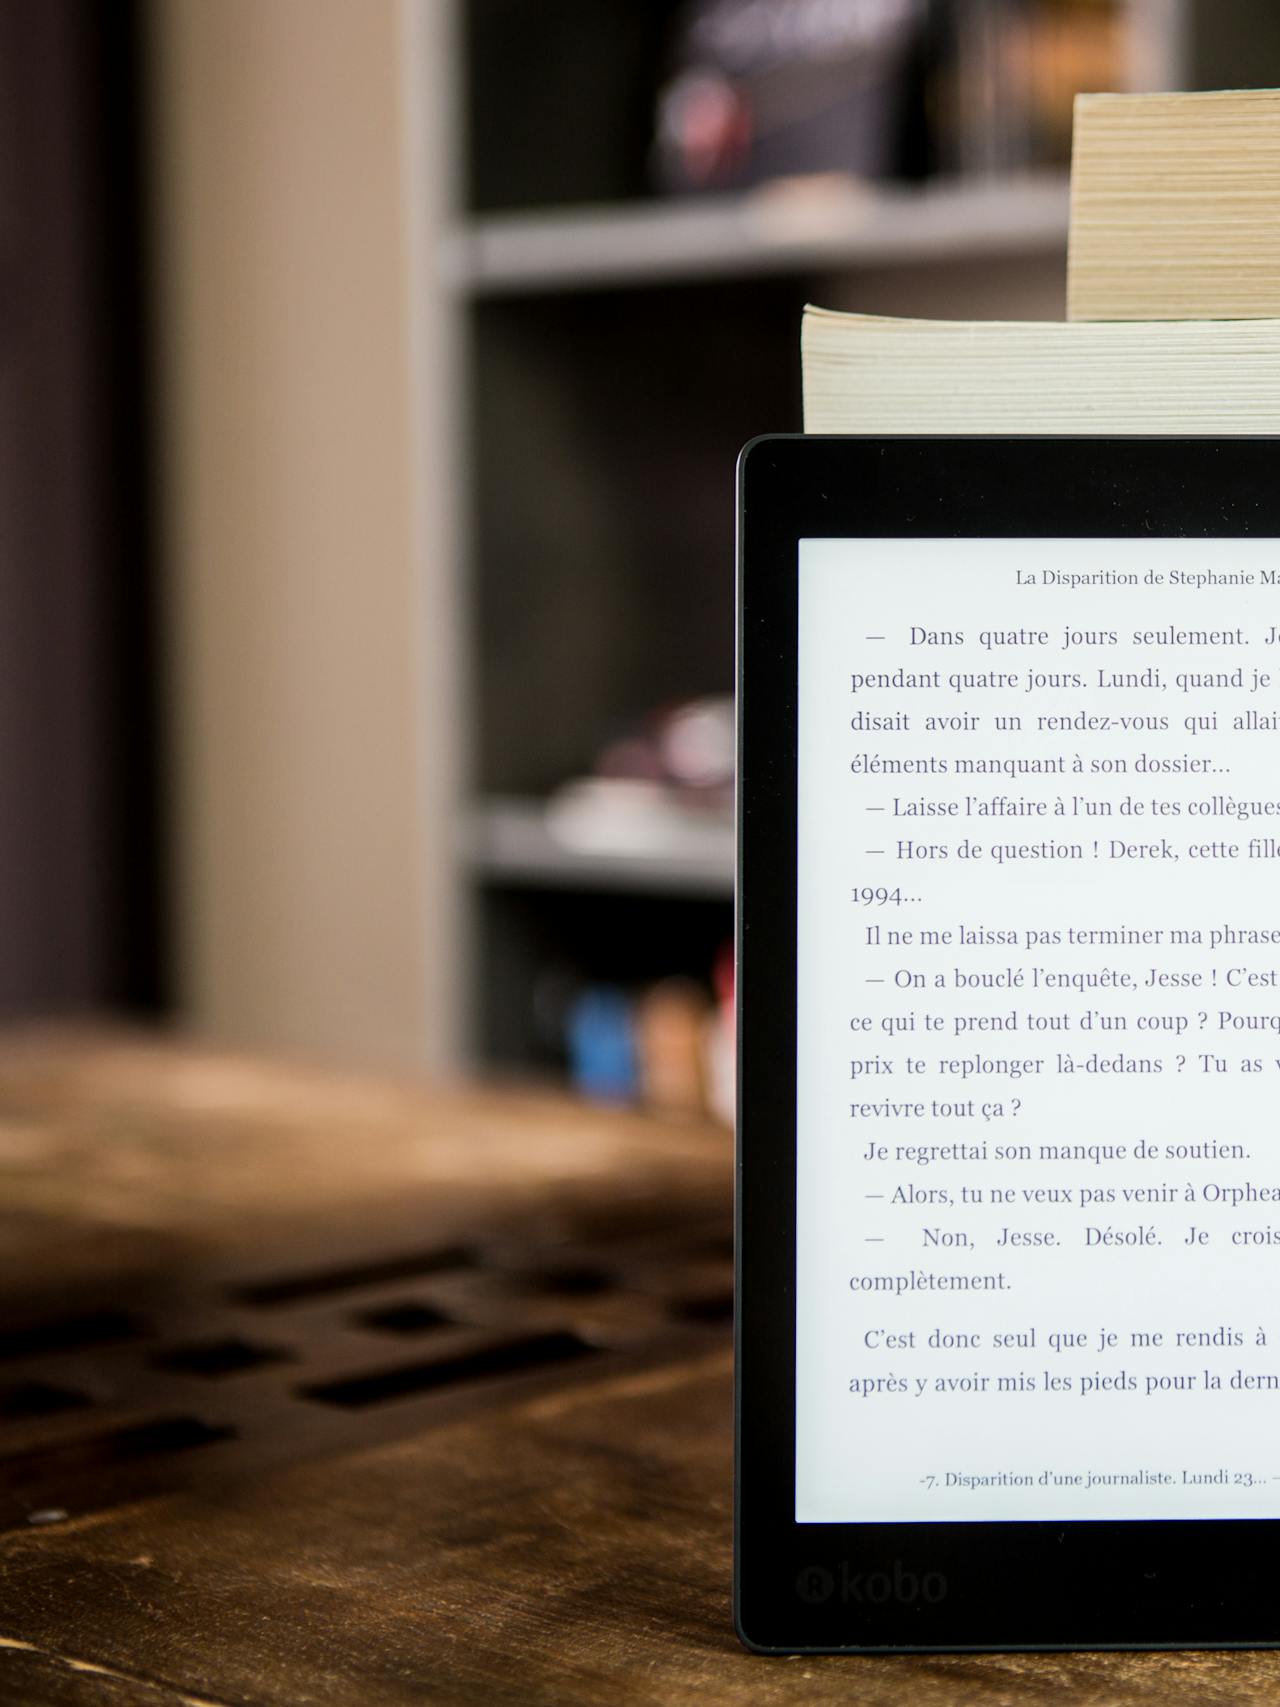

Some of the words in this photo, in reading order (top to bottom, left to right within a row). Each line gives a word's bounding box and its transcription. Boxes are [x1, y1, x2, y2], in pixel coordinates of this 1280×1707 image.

[1015, 569, 1037, 585] La
[1041, 569, 1139, 590] Disparition
[1143, 568, 1165, 585] de
[1168, 568, 1255, 590] Stephanie
[909, 626, 965, 646] Dans
[978, 628, 1049, 651] quatre
[1061, 625, 1121, 651] jours
[1132, 625, 1249, 646] seulement.
[850, 667, 941, 694] pendant
[948, 671, 1019, 694] quatre
[1024, 668, 1088, 694] jours.
[1097, 667, 1167, 692] Lundi,
[1175, 667, 1244, 694] quand
[1249, 668, 1271, 693] je
[850, 710, 911, 731] disait
[924, 711, 981, 731] avoir
[993, 716, 1022, 731] un
[1036, 710, 1169, 731] rendez-vous
[1183, 710, 1218, 736] qui
[850, 753, 948, 774] éléments
[953, 755, 1067, 779] manquant
[1090, 759, 1128, 774] son
[1134, 751, 1231, 774] dossier...
[892, 796, 959, 817] Laisse
[964, 795, 1048, 817] l’affaire
[1071, 795, 1113, 817] l’un
[1119, 795, 1145, 816] de
[1150, 799, 1182, 816] tes
[896, 840, 949, 860] Hors
[956, 838, 983, 860] de
[990, 839, 1083, 865] question
[1108, 838, 1180, 863] Derek,
[1188, 841, 1240, 859] cette
[851, 887, 922, 907] 1994...
[865, 924, 881, 946] Il
[887, 930, 913, 946] ne
[919, 930, 953, 945] me
[958, 924, 1019, 945] laissa
[1024, 930, 1062, 950] pas
[1066, 924, 1164, 945] terminer
[1169, 929, 1204, 945] ma
[894, 969, 927, 989] On
[933, 973, 947, 989] a
[953, 967, 1025, 989] bouclé
[1031, 967, 1138, 993] l’enquête,
[1144, 967, 1203, 988] Jesse
[1226, 967, 1278, 988] C’est
[849, 1016, 873, 1032] ce
[880, 1011, 916, 1037] qui
[923, 1013, 945, 1032] te
[953, 1010, 1019, 1037] prend
[1026, 1013, 1071, 1031] tout
[1079, 1009, 1128, 1031] d’un
[1136, 1015, 1189, 1037] coup
[849, 1054, 894, 1080] prix
[905, 1057, 926, 1075] te
[938, 1053, 1045, 1080] replonger
[1056, 1052, 1163, 1074] là-dedans
[1198, 1054, 1228, 1073] Tu
[1240, 1058, 1263, 1073] as
[849, 1097, 925, 1118] revivre
[930, 1099, 975, 1118] tout
[981, 1102, 1005, 1122] ça
[863, 1141, 889, 1161] Je
[895, 1140, 988, 1166] regrettai
[994, 1145, 1032, 1161] son
[1039, 1145, 1127, 1165] manque
[1132, 1138, 1159, 1160] de
[1164, 1139, 1251, 1160] soutien.
[890, 1183, 955, 1207] Alors,
[960, 1186, 983, 1204] tu
[989, 1189, 1016, 1205] ne
[1021, 1188, 1073, 1204] veux
[1079, 1188, 1116, 1209] pas
[1121, 1182, 1179, 1203] venir
[922, 1227, 975, 1251] Non,
[996, 1226, 1061, 1247] Jesse.
[1085, 1225, 1163, 1247] Désolé.
[1184, 1226, 1209, 1246] Je
[849, 1269, 1012, 1297] complètement.
[863, 1328, 916, 1350] C’est
[927, 1328, 981, 1349] donc
[992, 1327, 1036, 1348] seul
[1047, 1333, 1088, 1353] que
[1096, 1327, 1118, 1353] je
[1130, 1332, 1164, 1348] me
[1175, 1325, 1244, 1347] rendis
[848, 1371, 908, 1399] après
[914, 1378, 928, 1398] y
[934, 1371, 991, 1392] avoir
[997, 1371, 1036, 1392] mis
[1043, 1370, 1073, 1392] les
[1079, 1369, 1138, 1397] pieds
[1144, 1375, 1197, 1395] pour
[1203, 1369, 1222, 1391] la
[944, 1471, 1034, 1491] Disparition
[1037, 1469, 1083, 1488] d’une
[1084, 1469, 1178, 1491] journaliste.
[1181, 1468, 1229, 1485] Lundi
[1233, 1472, 1267, 1488] 23...
[840, 1559, 948, 1604] kobo
